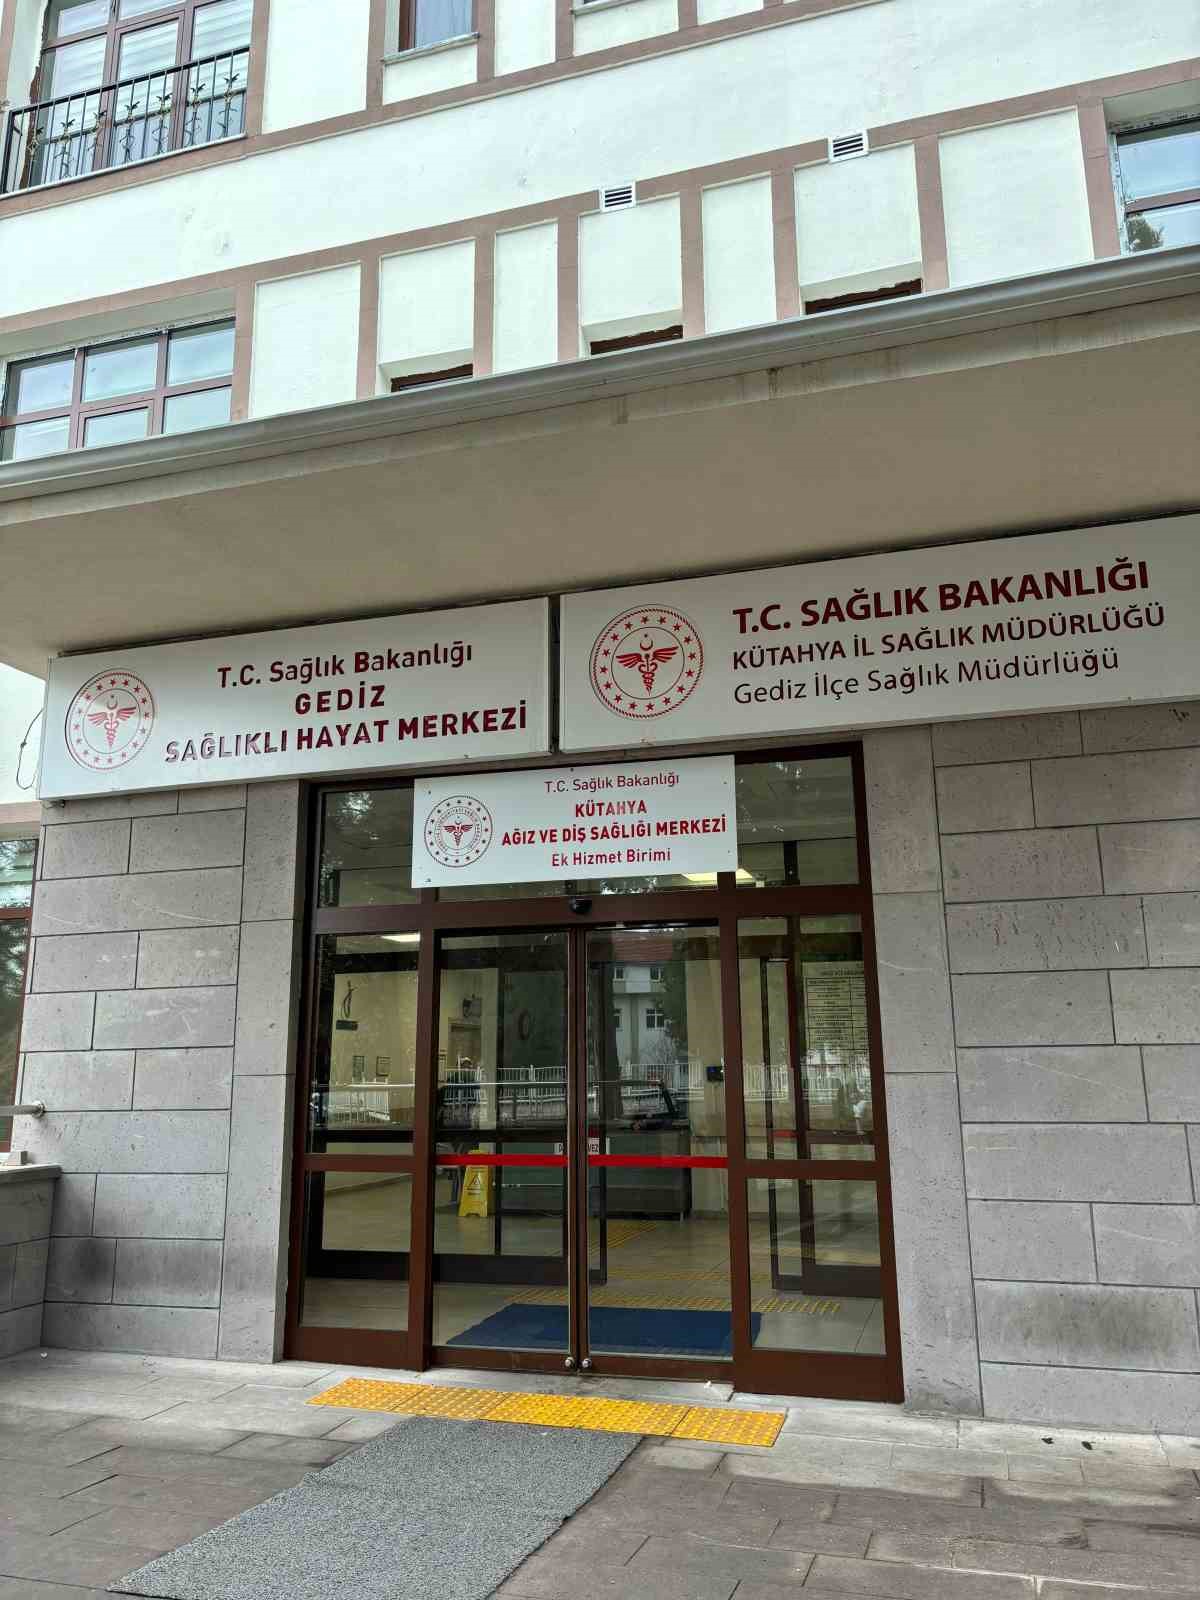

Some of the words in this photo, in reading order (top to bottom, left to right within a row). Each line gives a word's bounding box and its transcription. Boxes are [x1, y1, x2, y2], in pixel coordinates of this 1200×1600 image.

[732, 605, 792, 635] T.C.
[801, 586, 928, 628] SAĞLIK
[938, 557, 1149, 613] BAKANLIĞI
[732, 639, 846, 670] KÜTAHYA
[853, 632, 875, 658] İL
[882, 622, 975, 656] SAĞLIK
[982, 603, 1166, 645] MÜDÜRLÜĞÜ
[217, 666, 261, 689] T.C.
[269, 654, 345, 684] Sağlık
[355, 640, 473, 674] Bakanlığı
[733, 673, 807, 705] Gediz
[815, 666, 859, 701] İlçe
[868, 658, 949, 694] Sağlık
[958, 647, 1118, 683] Müdürlüğü
[294, 681, 386, 716] GEDİZ
[165, 729, 288, 763] SAĞLIKLI
[297, 719, 390, 751] HAYAT
[398, 700, 527, 740] MERKEZİ
[544, 780, 568, 793] T.C.
[572, 776, 614, 792] Sağlık
[617, 773, 680, 789] Bakanlığı
[501, 826, 536, 846] AĞIZ
[539, 828, 557, 844] VE
[562, 822, 586, 844] DİŞ
[590, 819, 651, 841] SAĞLIĞI
[656, 814, 726, 835] MERKEZİ
[575, 800, 647, 818] KÜTAHYA
[551, 853, 568, 867] Ek
[572, 849, 623, 866] Hizmet
[627, 847, 671, 863] Birimi
